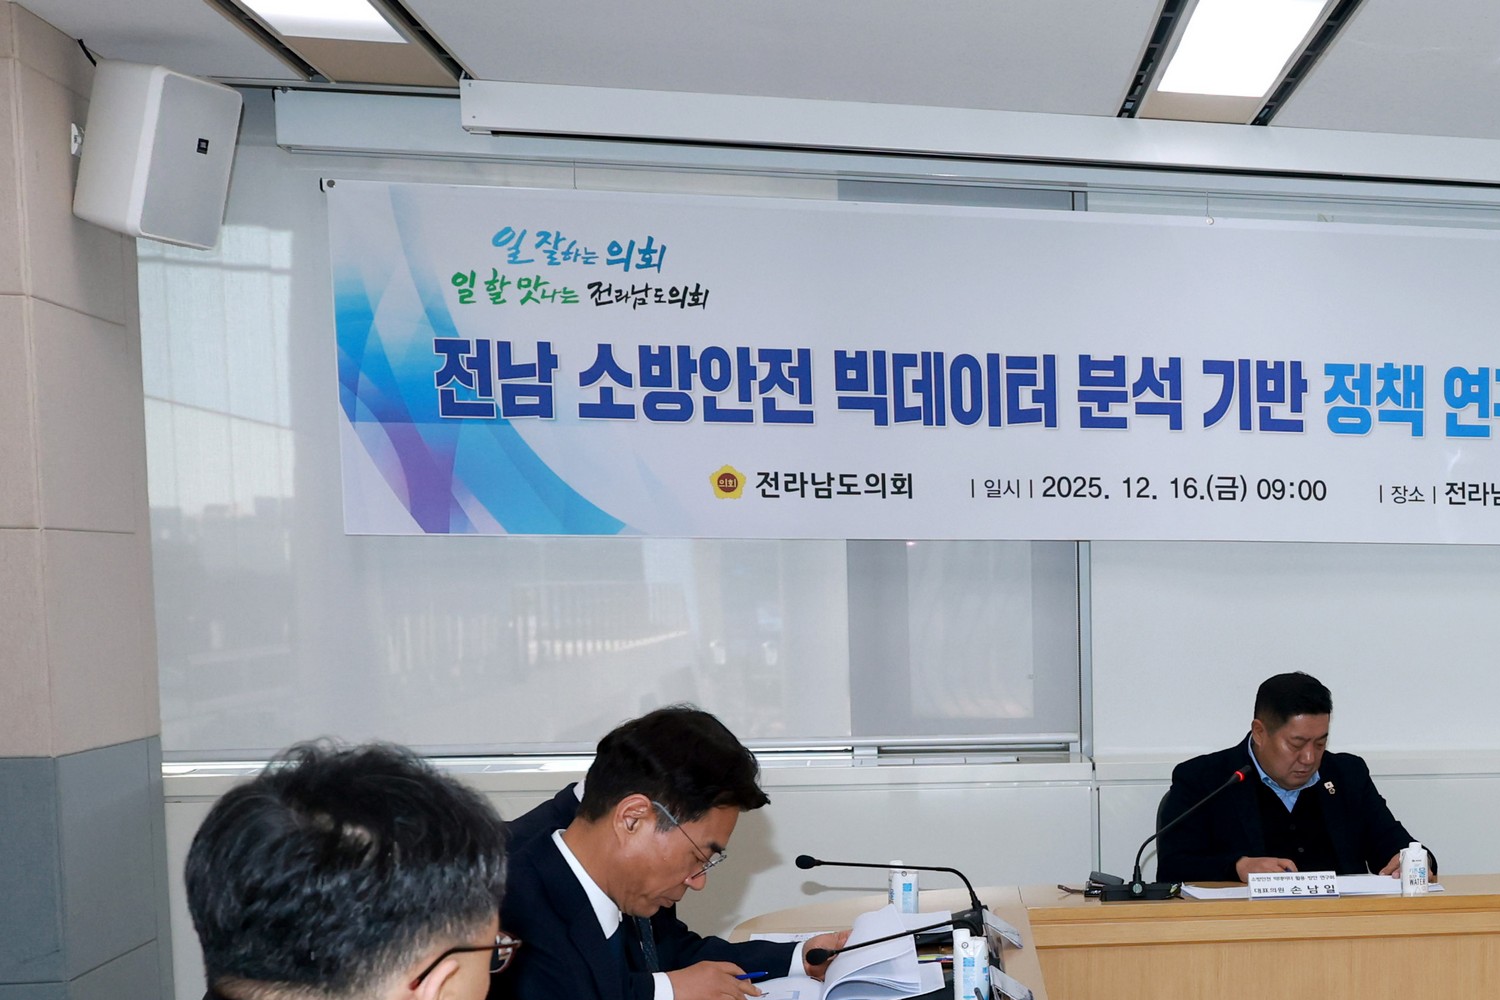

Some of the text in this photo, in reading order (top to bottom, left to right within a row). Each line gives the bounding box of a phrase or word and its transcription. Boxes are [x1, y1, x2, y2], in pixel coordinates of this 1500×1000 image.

[491, 226, 667, 274] 일 잘하는 의회
[451, 267, 710, 311] 일 할 맛나는 전라남도의회
[433, 337, 557, 421] 전남
[578, 343, 814, 424] 소방안전
[836, 350, 1057, 429] 빅데이터
[1078, 354, 1184, 431] 분석
[1203, 358, 1308, 433] 기반
[1323, 361, 1425, 438] 정책
[718, 478, 737, 488] 의회
[755, 471, 914, 500] 전라남도의회
[1042, 475, 1110, 500] 2025.
[1122, 476, 1158, 500] 12.
[1170, 474, 1248, 503] 16.(금)
[1256, 478, 1327, 502] 09:00
